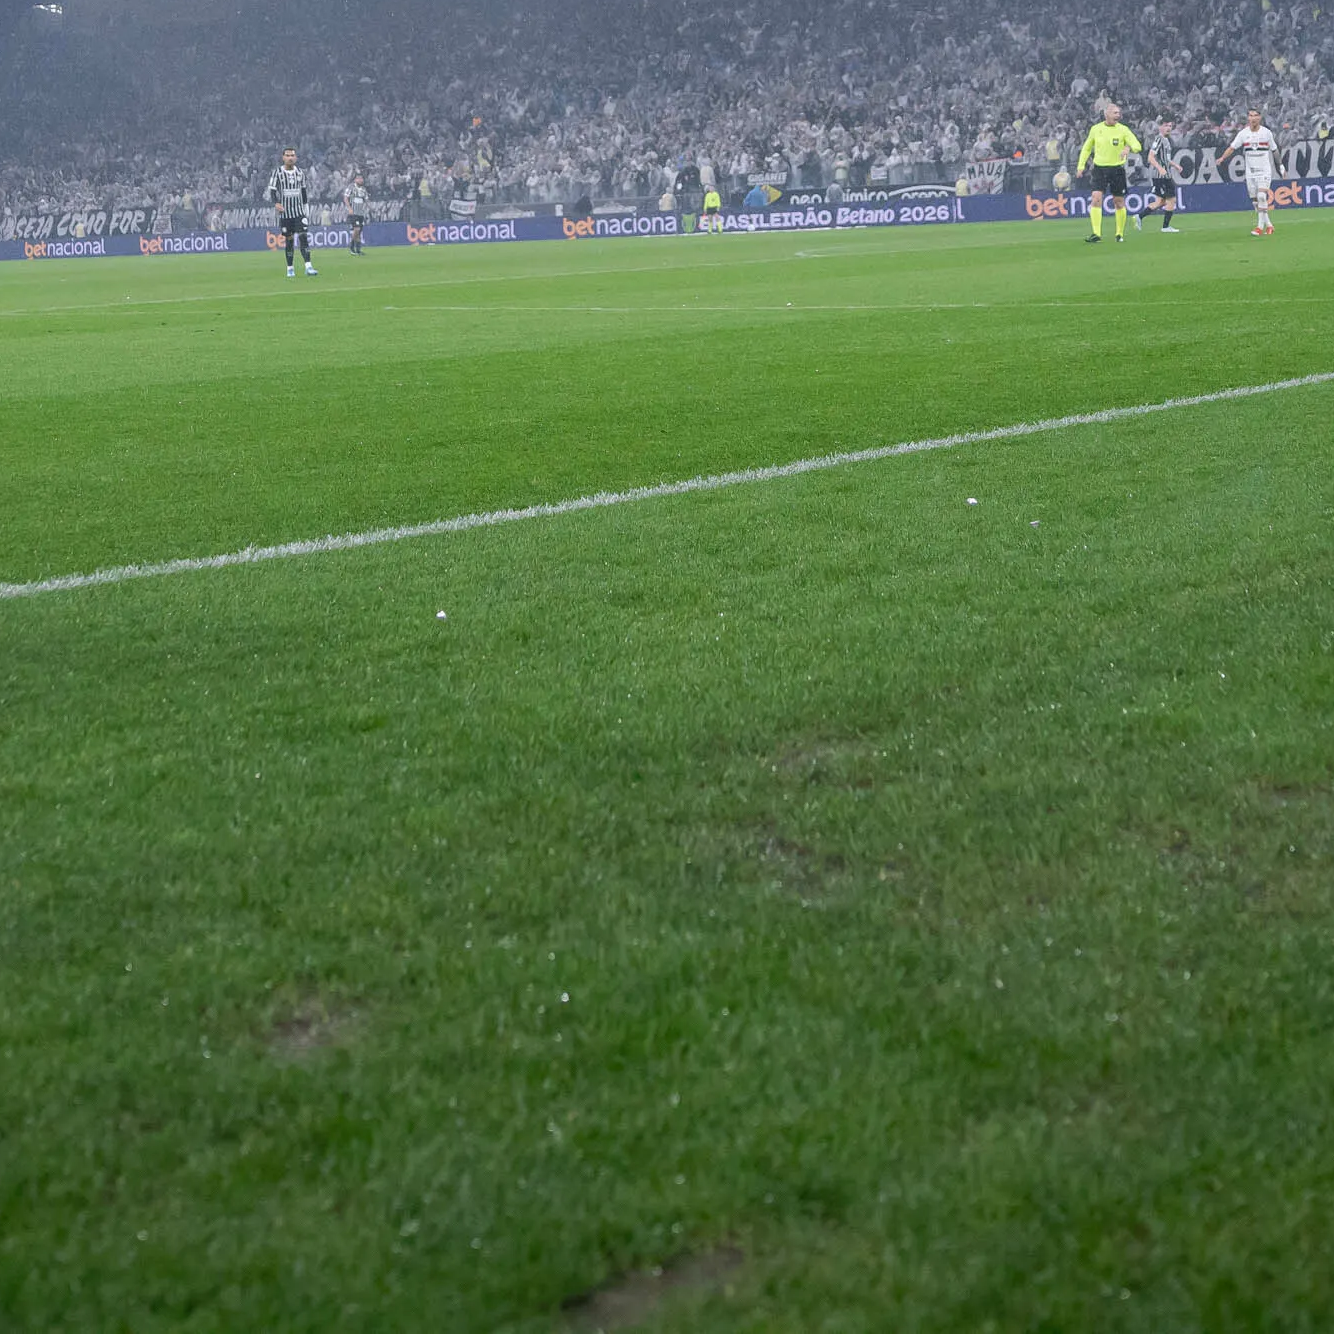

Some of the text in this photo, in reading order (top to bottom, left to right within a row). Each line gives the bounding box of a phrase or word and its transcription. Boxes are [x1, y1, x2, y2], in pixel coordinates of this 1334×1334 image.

[109, 209, 145, 236] FOR
[835, 207, 895, 225] Betano
[898, 204, 950, 222] 2026
[139, 231, 229, 255] betnacional
[407, 220, 516, 244] betnacional
[24, 236, 106, 259] betnacional
